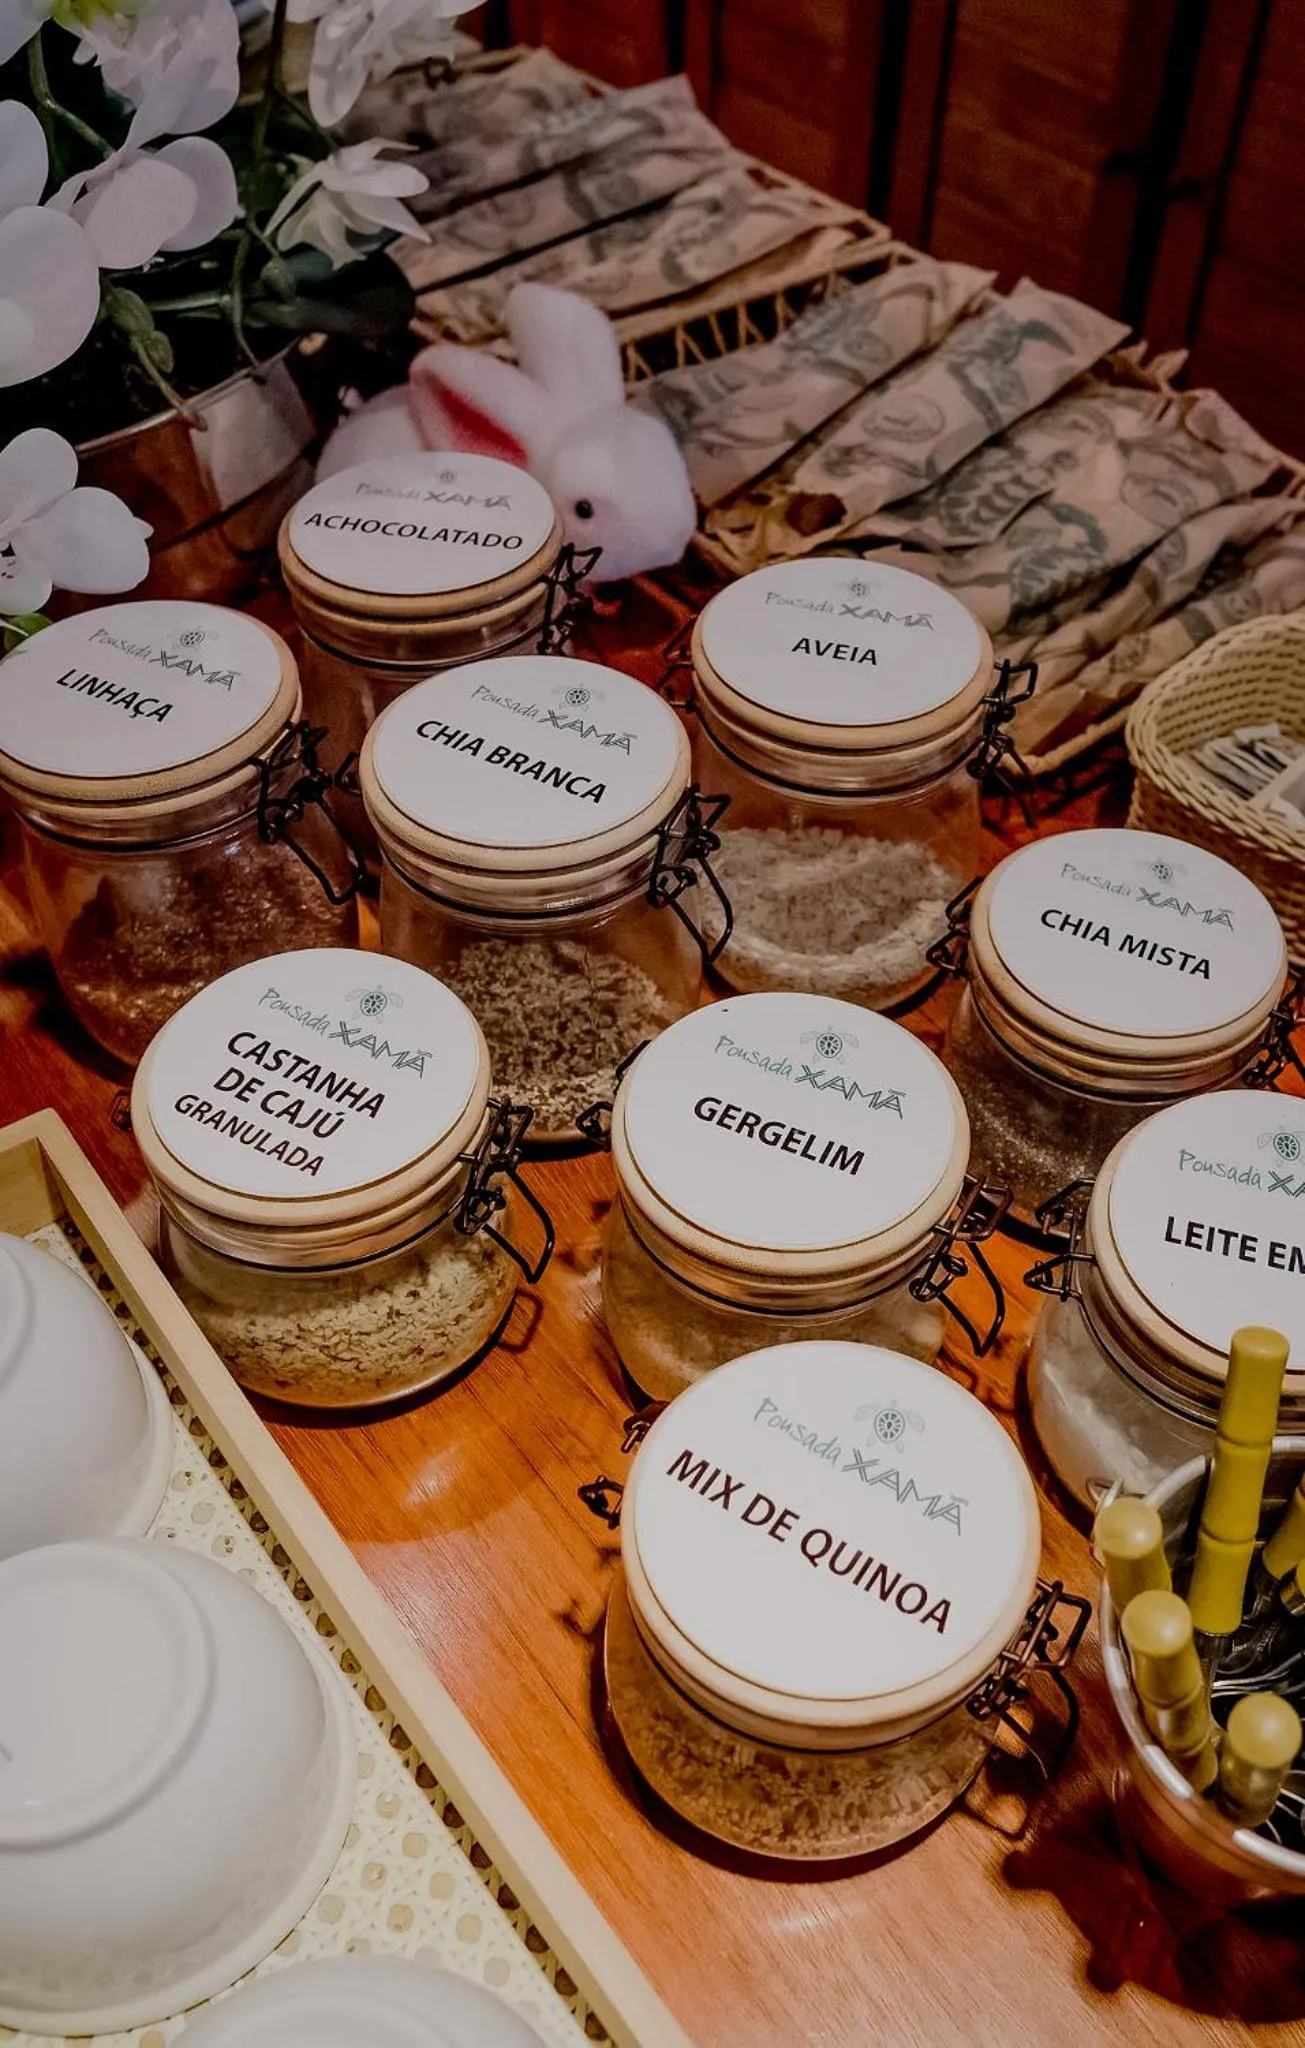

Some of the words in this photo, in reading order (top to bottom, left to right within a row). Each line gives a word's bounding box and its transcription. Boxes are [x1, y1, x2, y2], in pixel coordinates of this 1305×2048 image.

[304, 513, 523, 550] ACHOCOLATADO
[791, 638, 878, 665] AVEIA
[56, 669, 173, 722] LINHAÇA
[471, 685, 541, 720] Pousada
[416, 720, 485, 757] CHIA
[485, 745, 607, 804] BRANCA
[1060, 863, 1132, 897] Pousada
[1041, 909, 1110, 947] CHIA
[1118, 934, 1211, 980] MISTA
[257, 988, 330, 1036] Pousada
[227, 1031, 387, 1119] CASTANHA
[714, 1034, 793, 1081] Pousada
[213, 1067, 265, 1103] DE
[260, 1090, 346, 1139] CAJÚ
[174, 1094, 325, 1176] GRANULADA
[694, 1096, 865, 1175] GERGELIM
[1178, 1148, 1262, 1191] Pousada
[1164, 1216, 1258, 1263] LEITE
[753, 1396, 843, 1468] Pousada
[665, 1449, 745, 1511] MIX
[740, 1492, 801, 1542] DE
[799, 1528, 952, 1635] QUINOA
